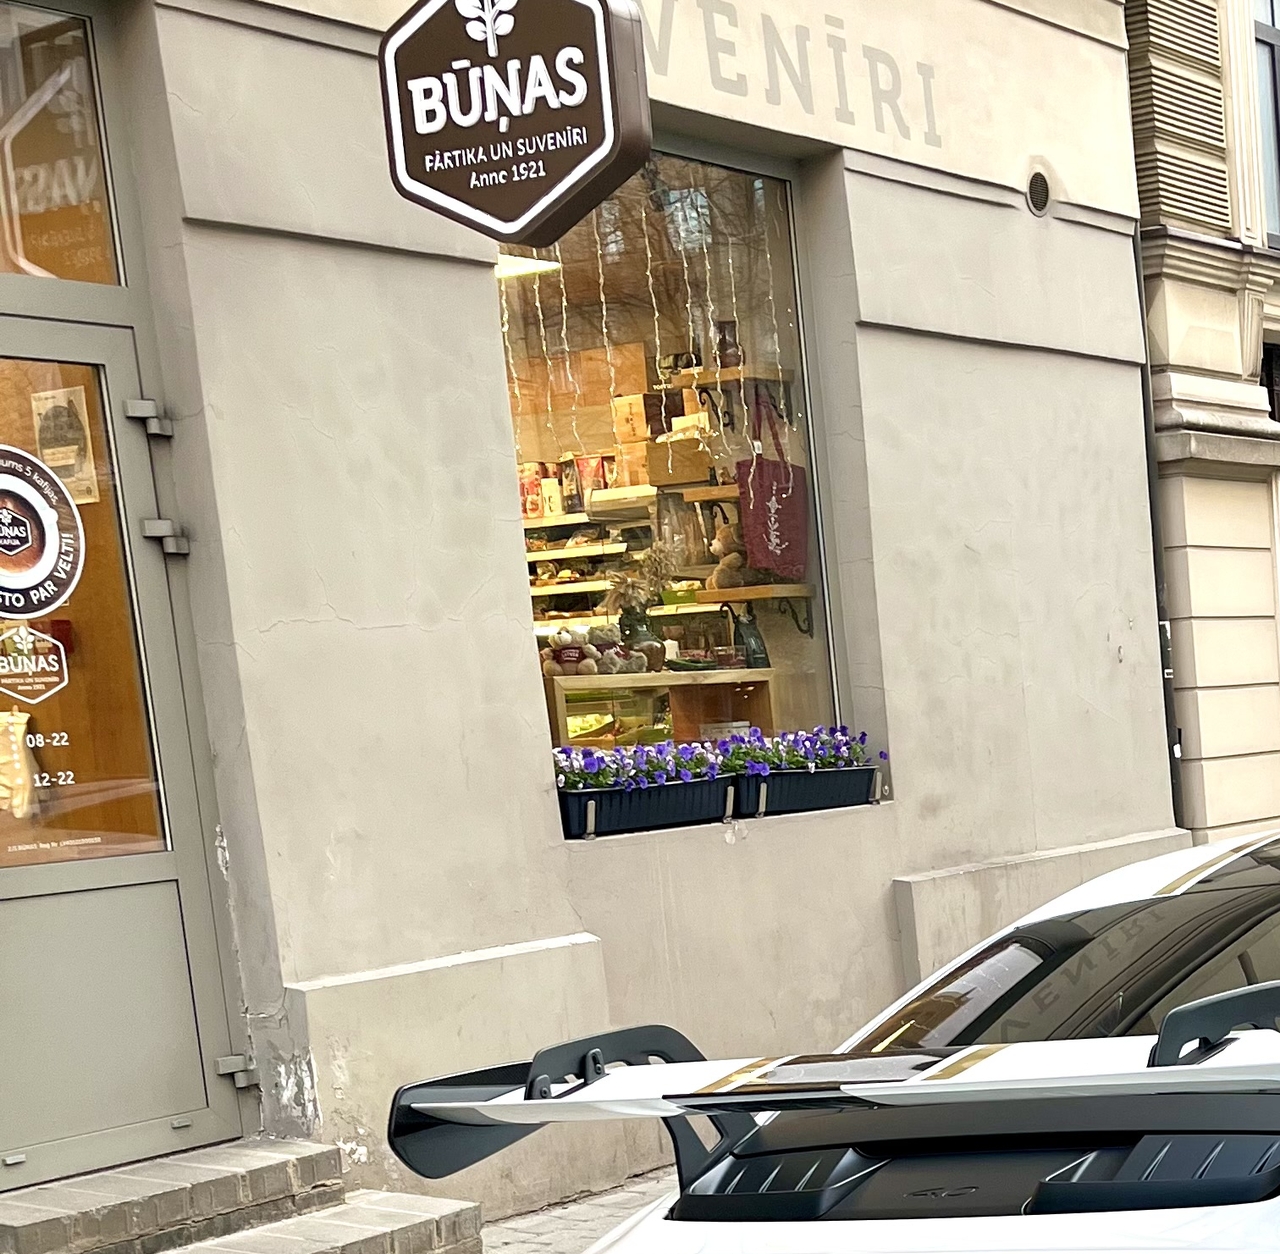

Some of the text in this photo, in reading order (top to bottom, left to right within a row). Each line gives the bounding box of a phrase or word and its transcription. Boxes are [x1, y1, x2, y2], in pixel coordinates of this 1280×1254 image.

[407, 46, 588, 134] BŪŅAS
[424, 126, 588, 173] PĀRTIKA UN SUVENĪRI
[511, 160, 547, 183] 1921
[23, 464, 33, 477] 5
[29, 580, 59, 605] PAR
[0, 653, 60, 677] BŪŅAS
[26, 732, 70, 748] 08-22
[33, 771, 76, 788] 12-22
